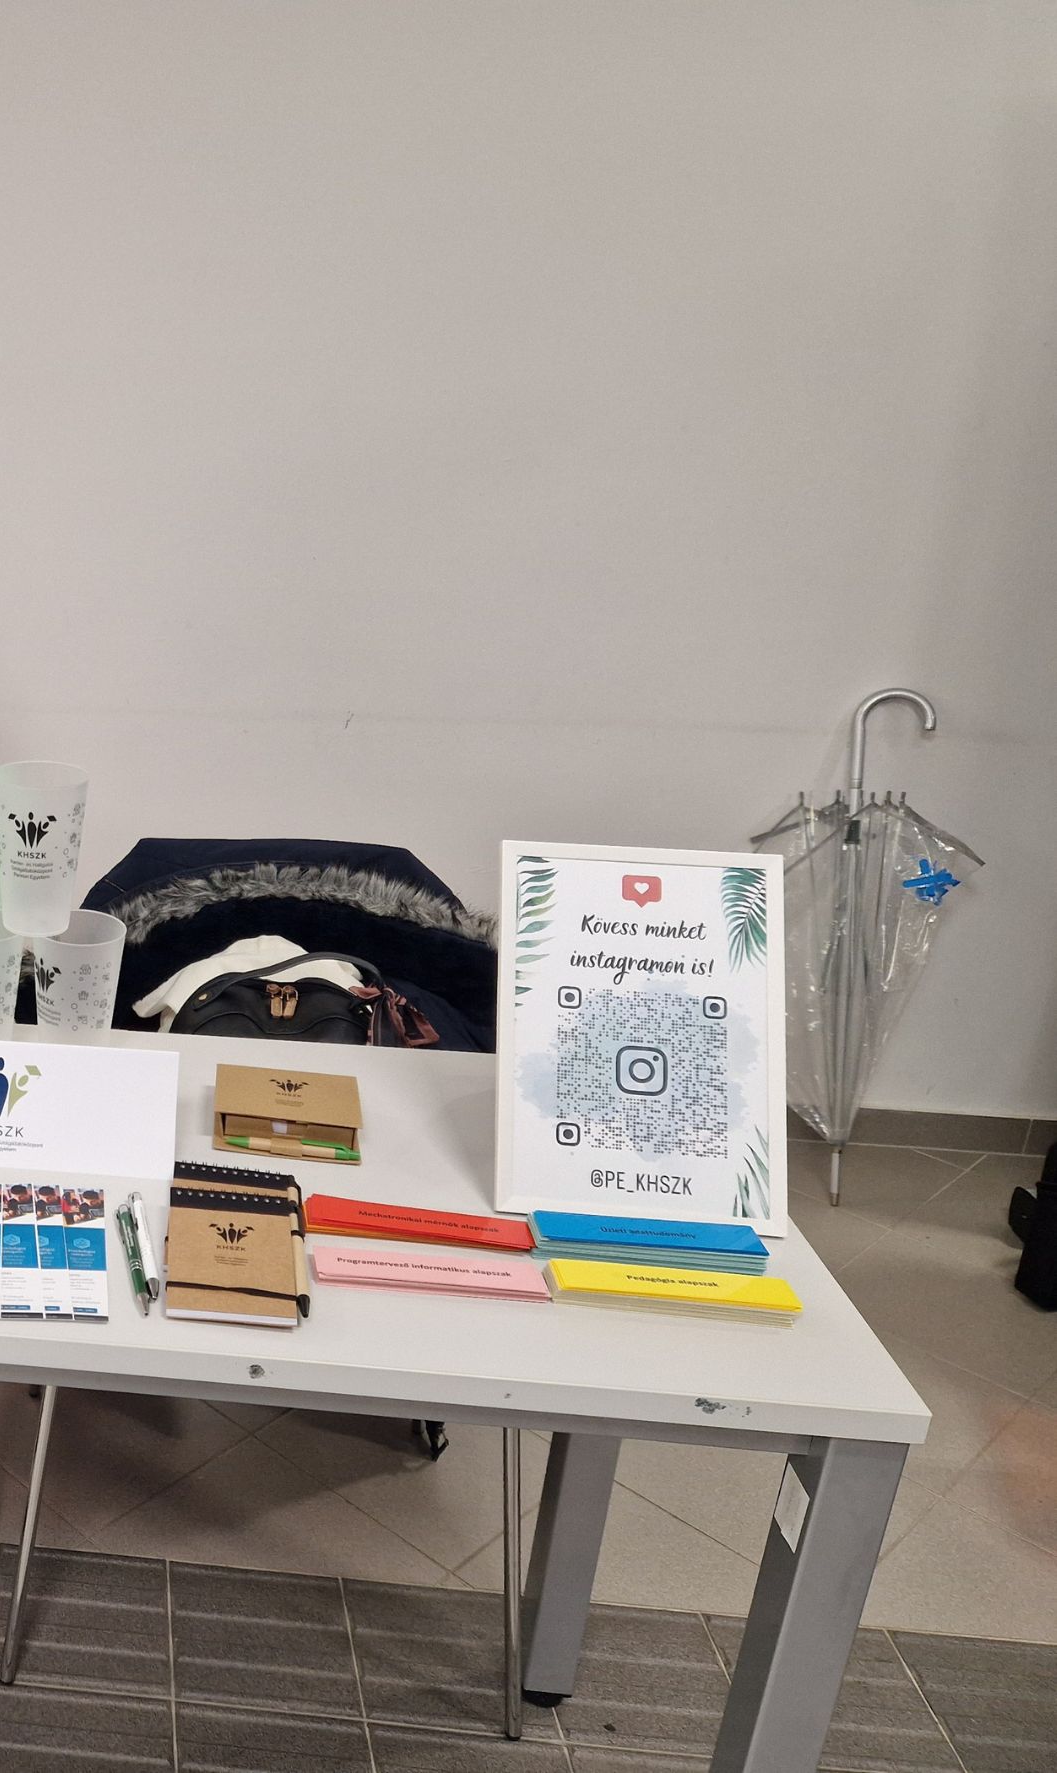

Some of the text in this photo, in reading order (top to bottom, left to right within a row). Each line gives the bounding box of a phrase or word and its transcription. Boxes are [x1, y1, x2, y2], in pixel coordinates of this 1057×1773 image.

[17, 850, 47, 859] KHSZK
[581, 914, 707, 941] Kövess minket
[570, 951, 714, 985] instagramon is!
[590, 1168, 692, 1196] @PE_KHSZK
[337, 1257, 512, 1278] Programtervező informatikus alapszak
[678, 1278, 719, 1288] alapszak
